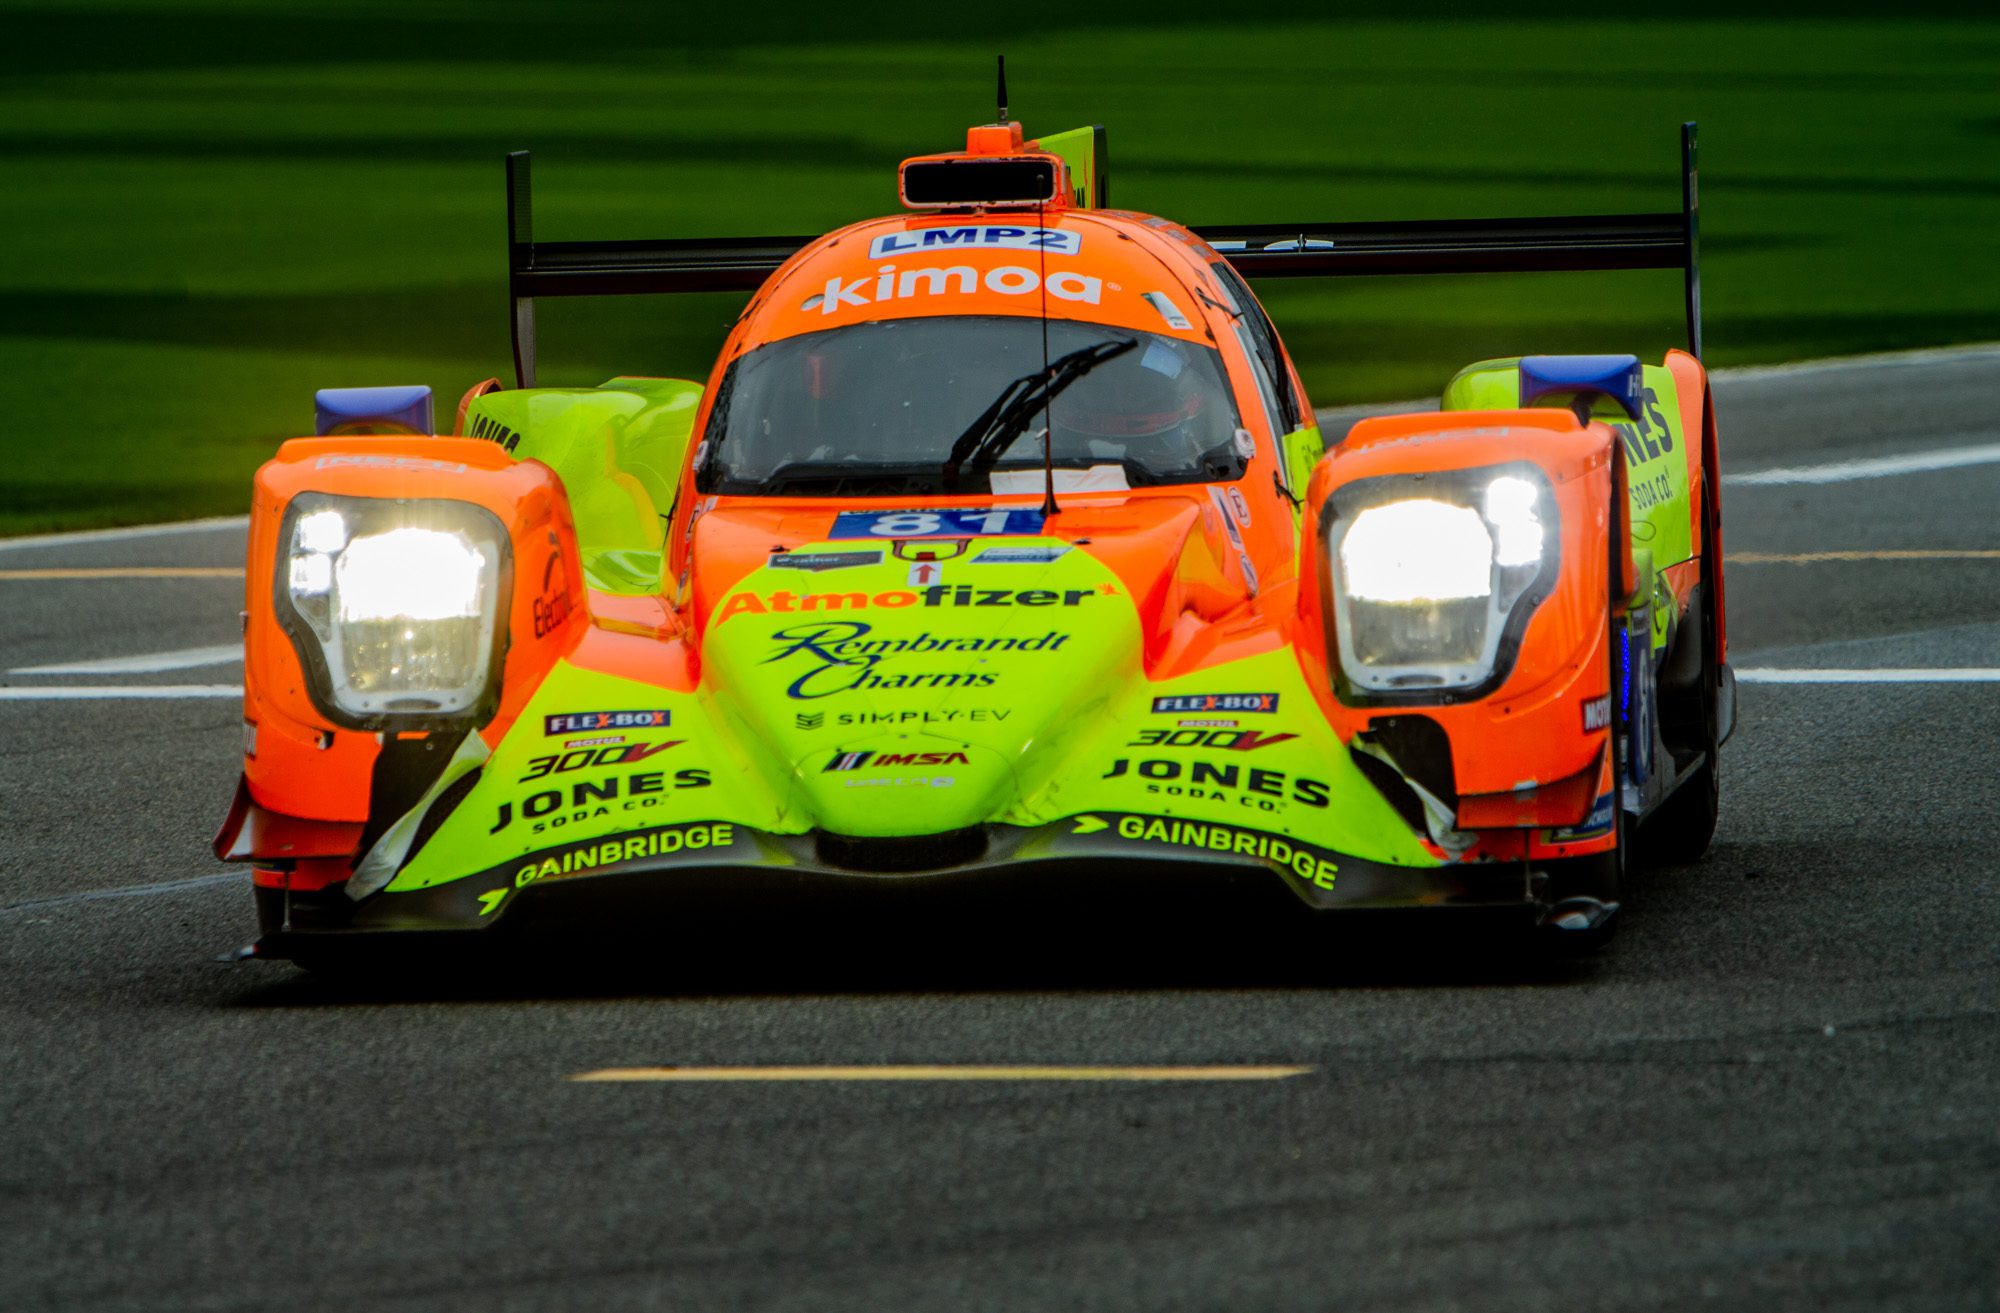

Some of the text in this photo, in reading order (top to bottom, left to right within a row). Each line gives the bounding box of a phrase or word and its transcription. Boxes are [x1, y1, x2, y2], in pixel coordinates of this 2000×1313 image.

[880, 226, 1070, 254] LMP2
[822, 264, 1103, 316] kimoa
[1629, 480, 1659, 511] SODA
[869, 513, 1011, 536] 81
[714, 584, 1095, 629] Atmofizer
[755, 621, 1072, 666] Rembrandt
[786, 654, 1000, 700] Charms
[1157, 694, 1274, 713] FLEX-BOX
[550, 711, 667, 733] FLEX-BOX
[1179, 720, 1239, 728] MOTUL
[567, 736, 625, 749] MOTUL
[1127, 730, 1301, 752] 300V
[518, 739, 688, 784] 300V
[872, 751, 970, 767] IMSA
[1102, 758, 1331, 809] JONES
[1146, 784, 1227, 802] SODA
[489, 769, 712, 836] JONES
[532, 806, 610, 835] SODA
[515, 823, 735, 889] GAINBRIDGE
[1117, 815, 1339, 891] GAINBRIDGE
